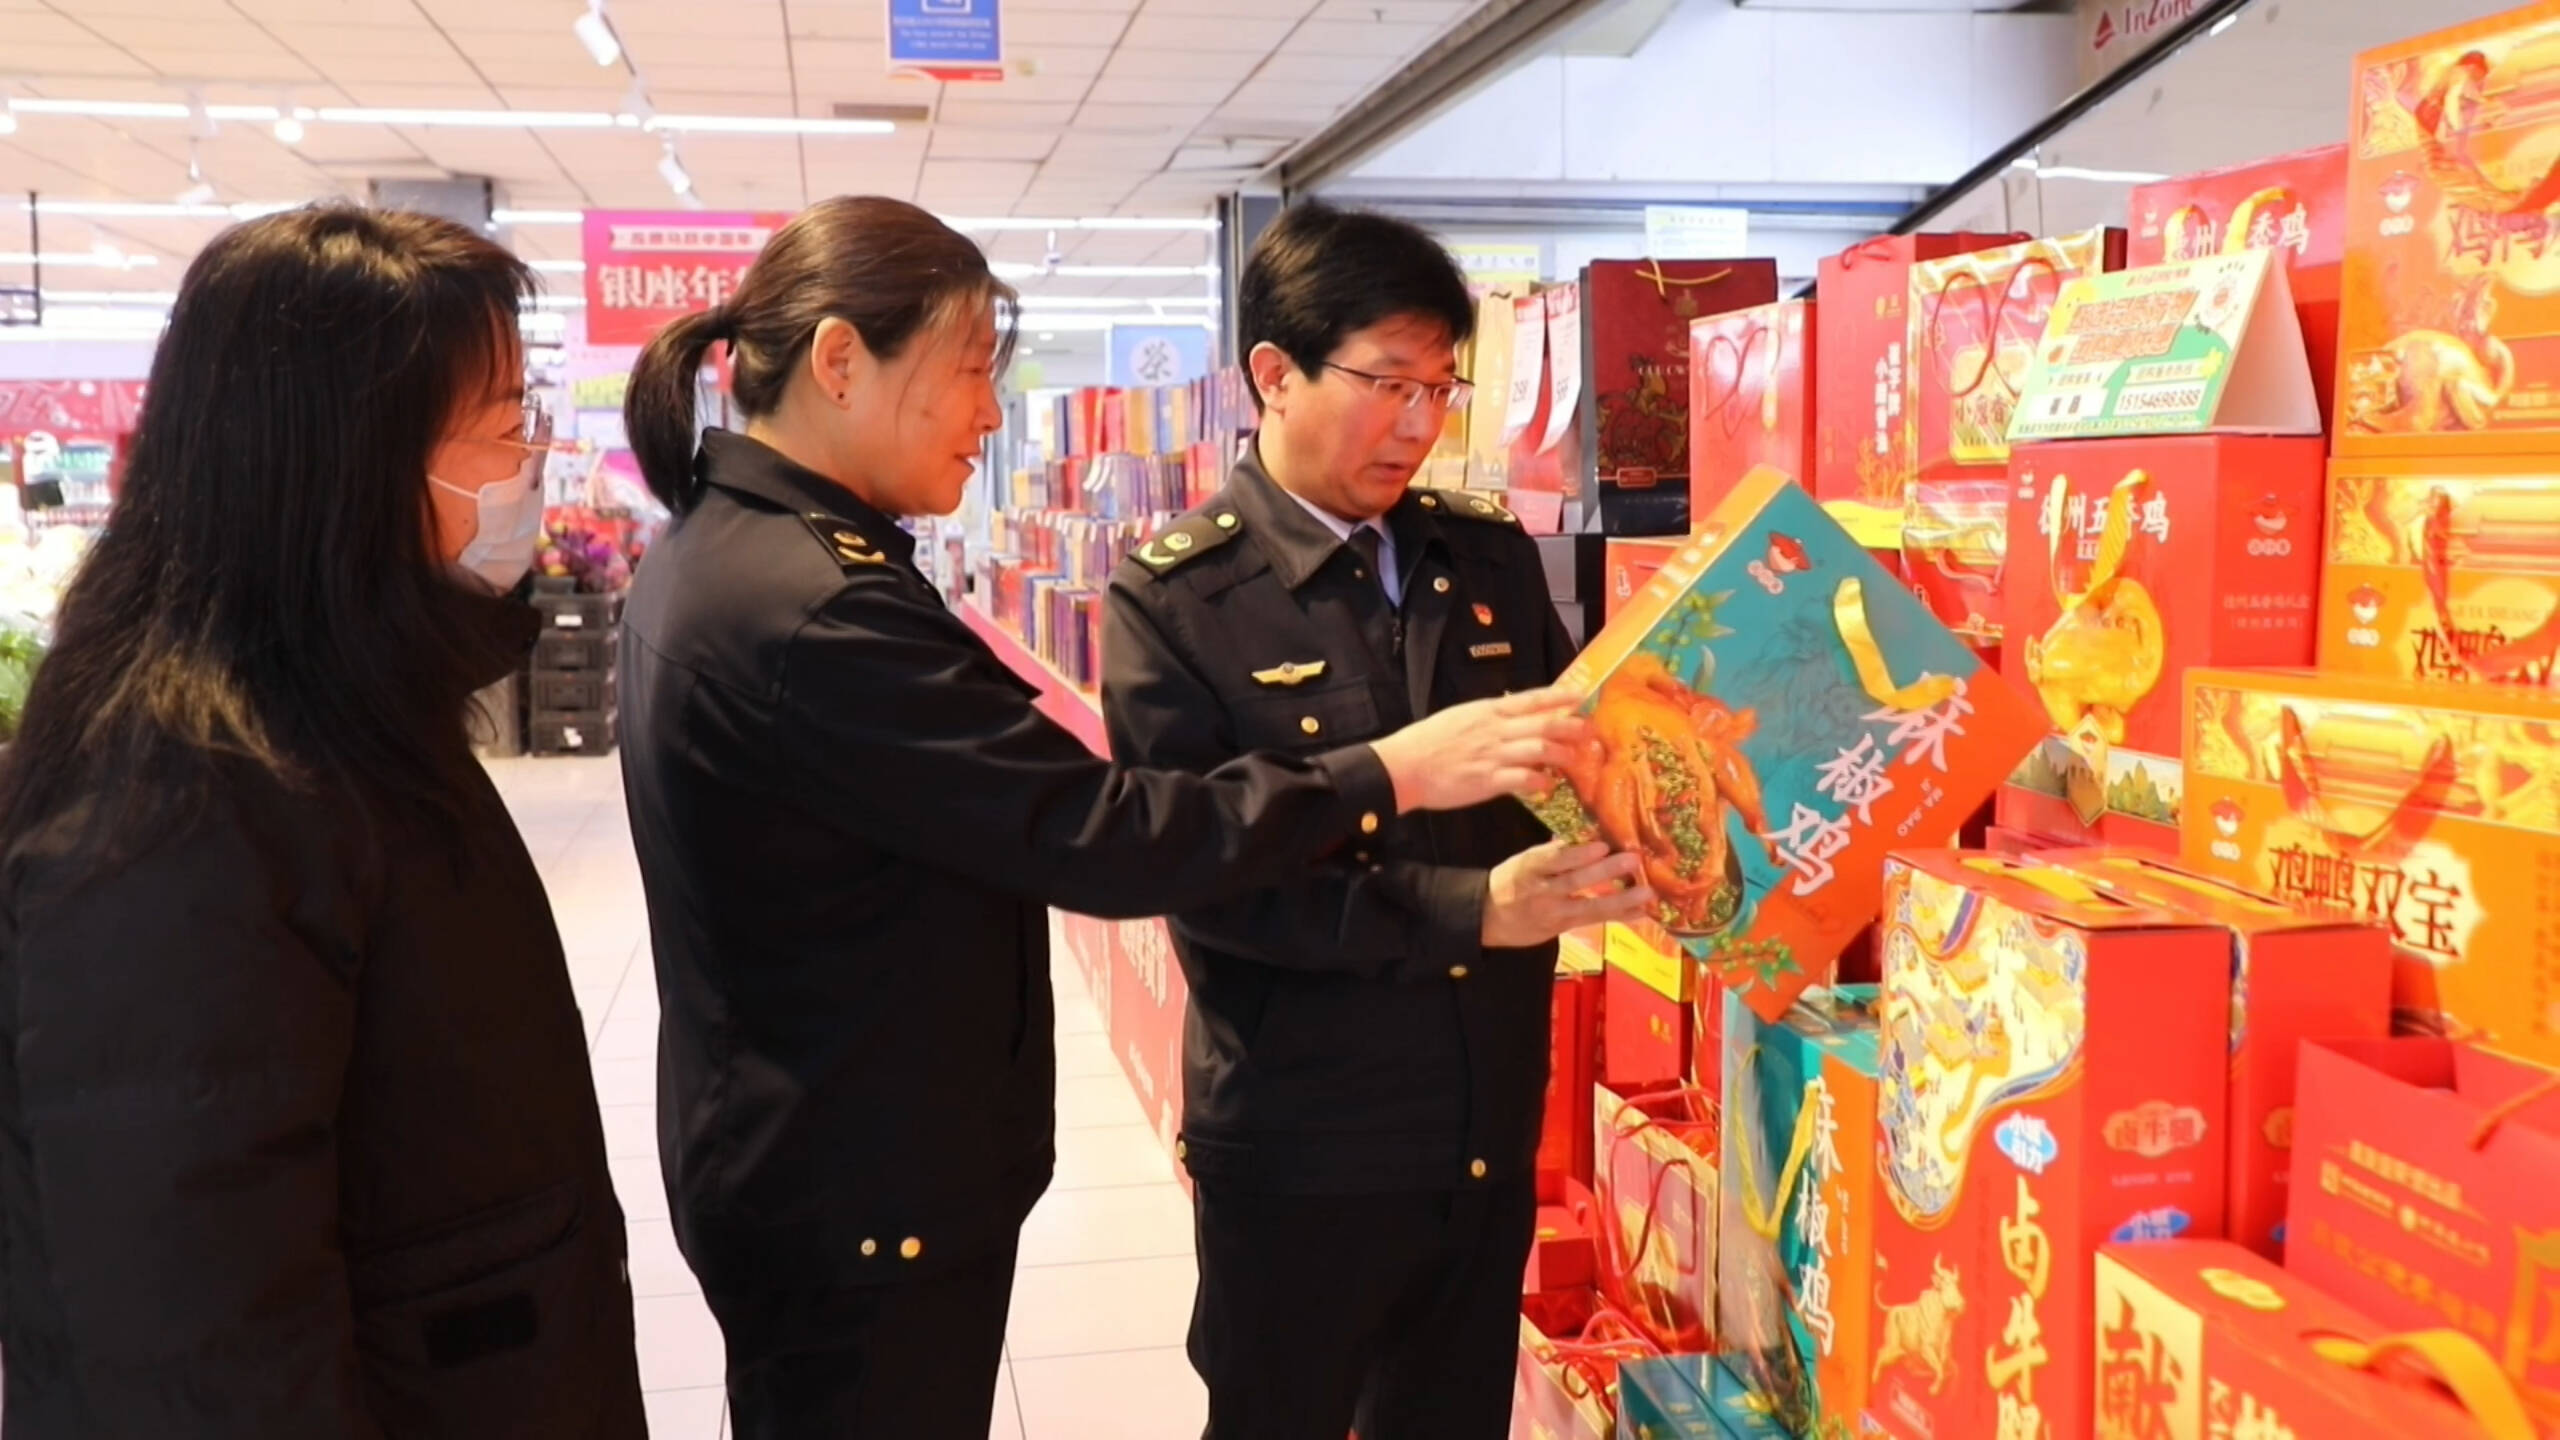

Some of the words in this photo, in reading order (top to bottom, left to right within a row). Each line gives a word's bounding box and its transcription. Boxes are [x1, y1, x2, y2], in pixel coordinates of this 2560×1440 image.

[2166, 201, 2310, 257] 州香鸡
[598, 264, 750, 309] 银座年
[2037, 490, 2171, 543] 州五鸡
[1762, 672, 1975, 897] 麻椒鸡
